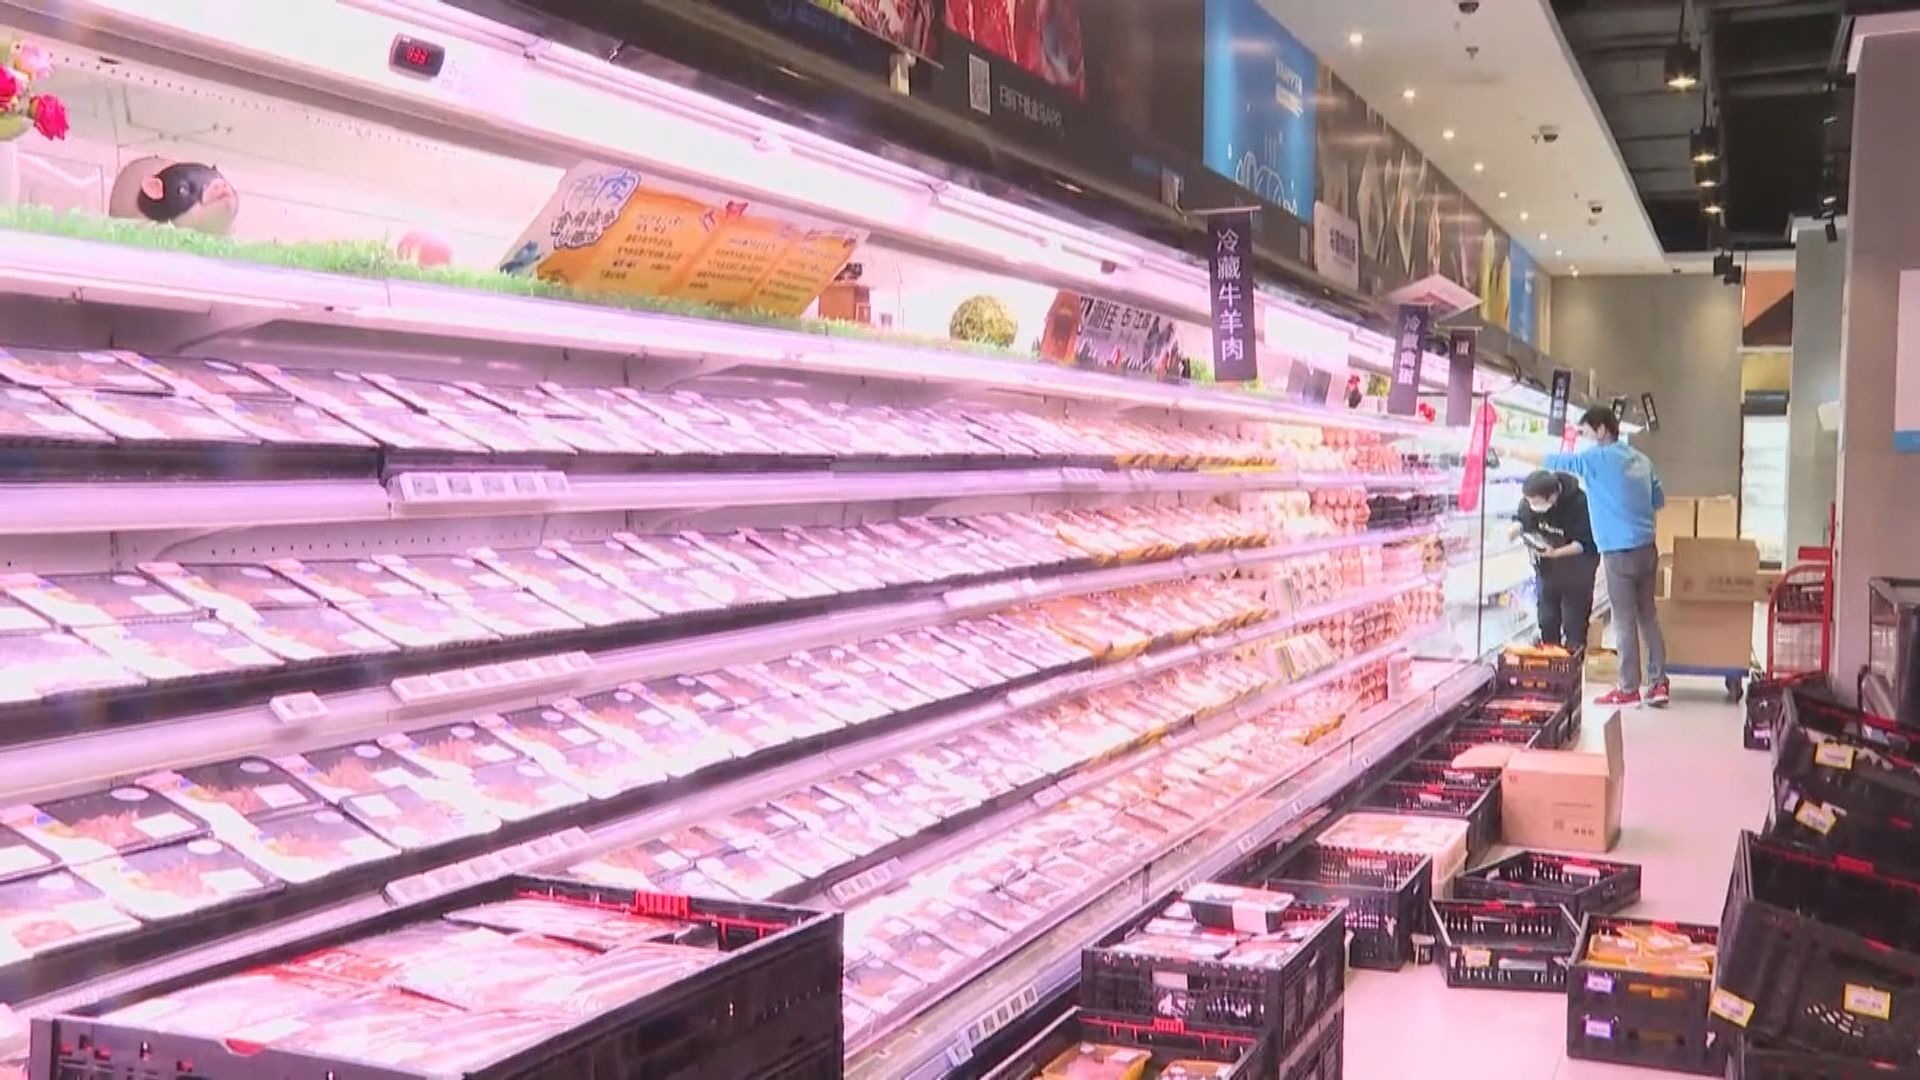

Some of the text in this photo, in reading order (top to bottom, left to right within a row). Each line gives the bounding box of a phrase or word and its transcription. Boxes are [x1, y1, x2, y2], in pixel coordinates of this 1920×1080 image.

[1216, 227, 1244, 362] 冷藏牛羊肉
